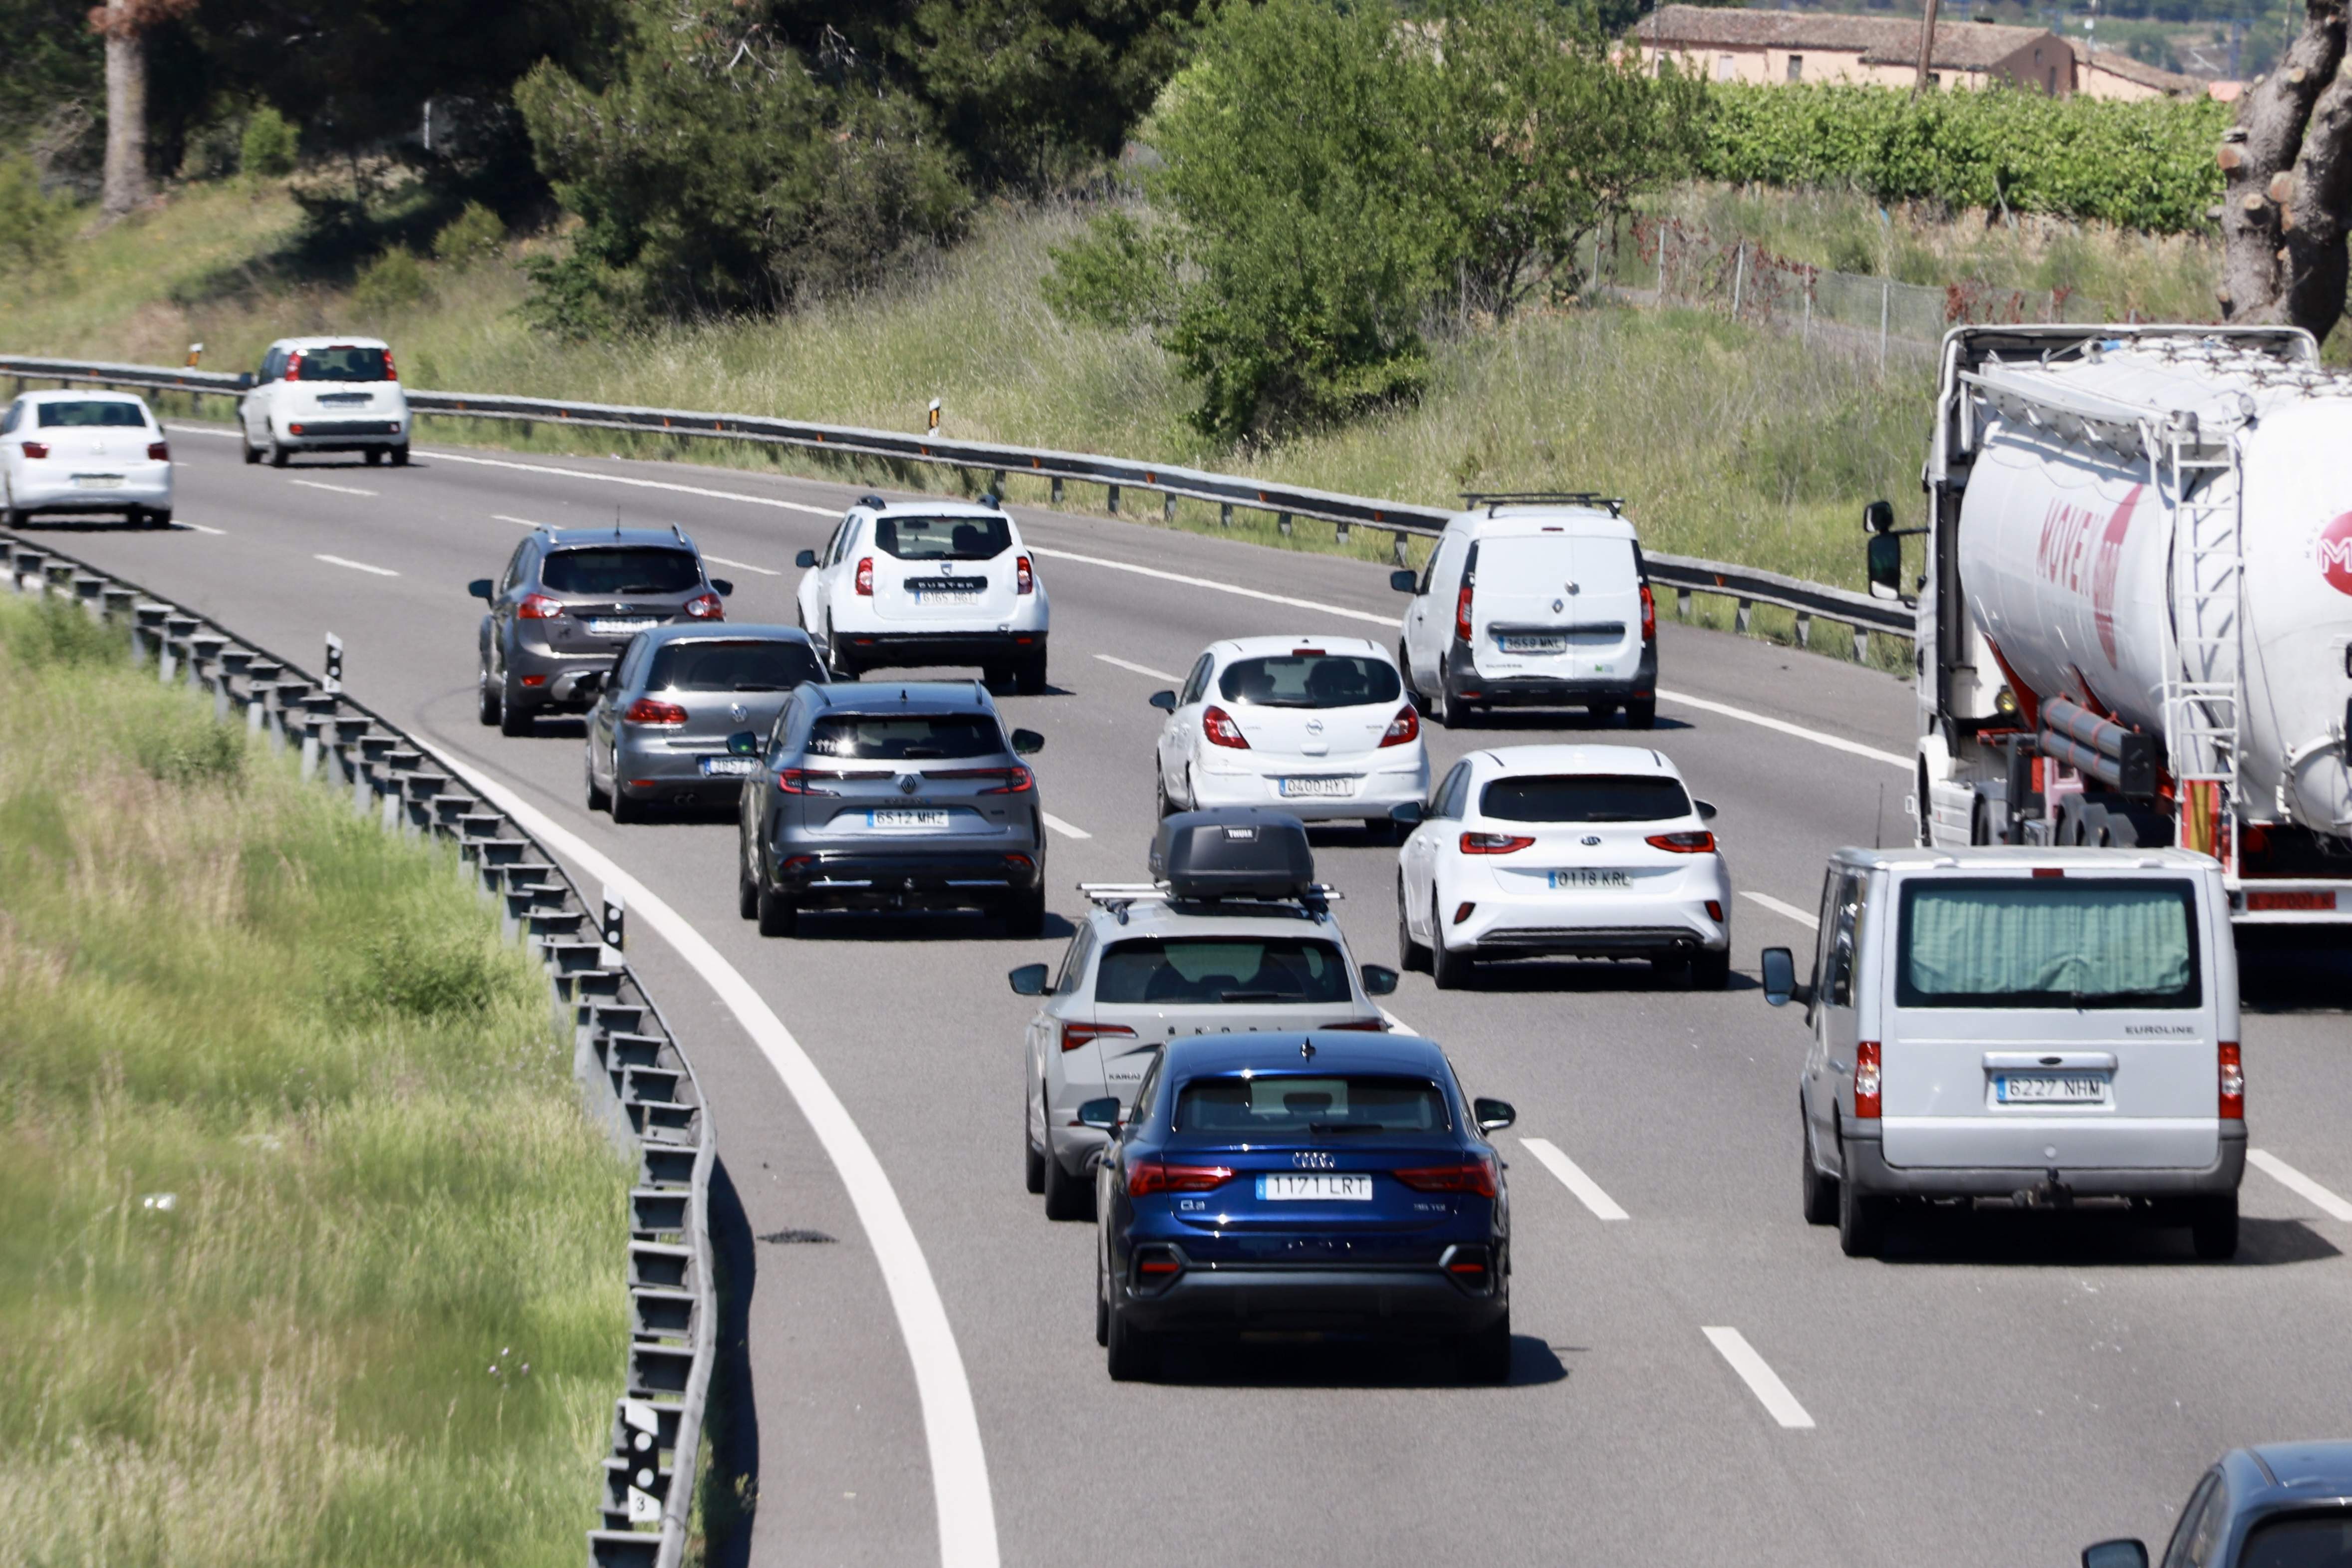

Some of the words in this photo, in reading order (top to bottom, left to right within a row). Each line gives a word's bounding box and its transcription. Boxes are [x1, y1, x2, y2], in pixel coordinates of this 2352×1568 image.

[1558, 871, 1596, 886] 0118
[1602, 871, 1630, 886] KRL
[2125, 1026, 2195, 1035] EUROLINE
[2010, 1078, 2057, 1096] 6227
[1274, 1176, 1319, 1195] 1171
[1329, 1176, 1366, 1195] LRT
